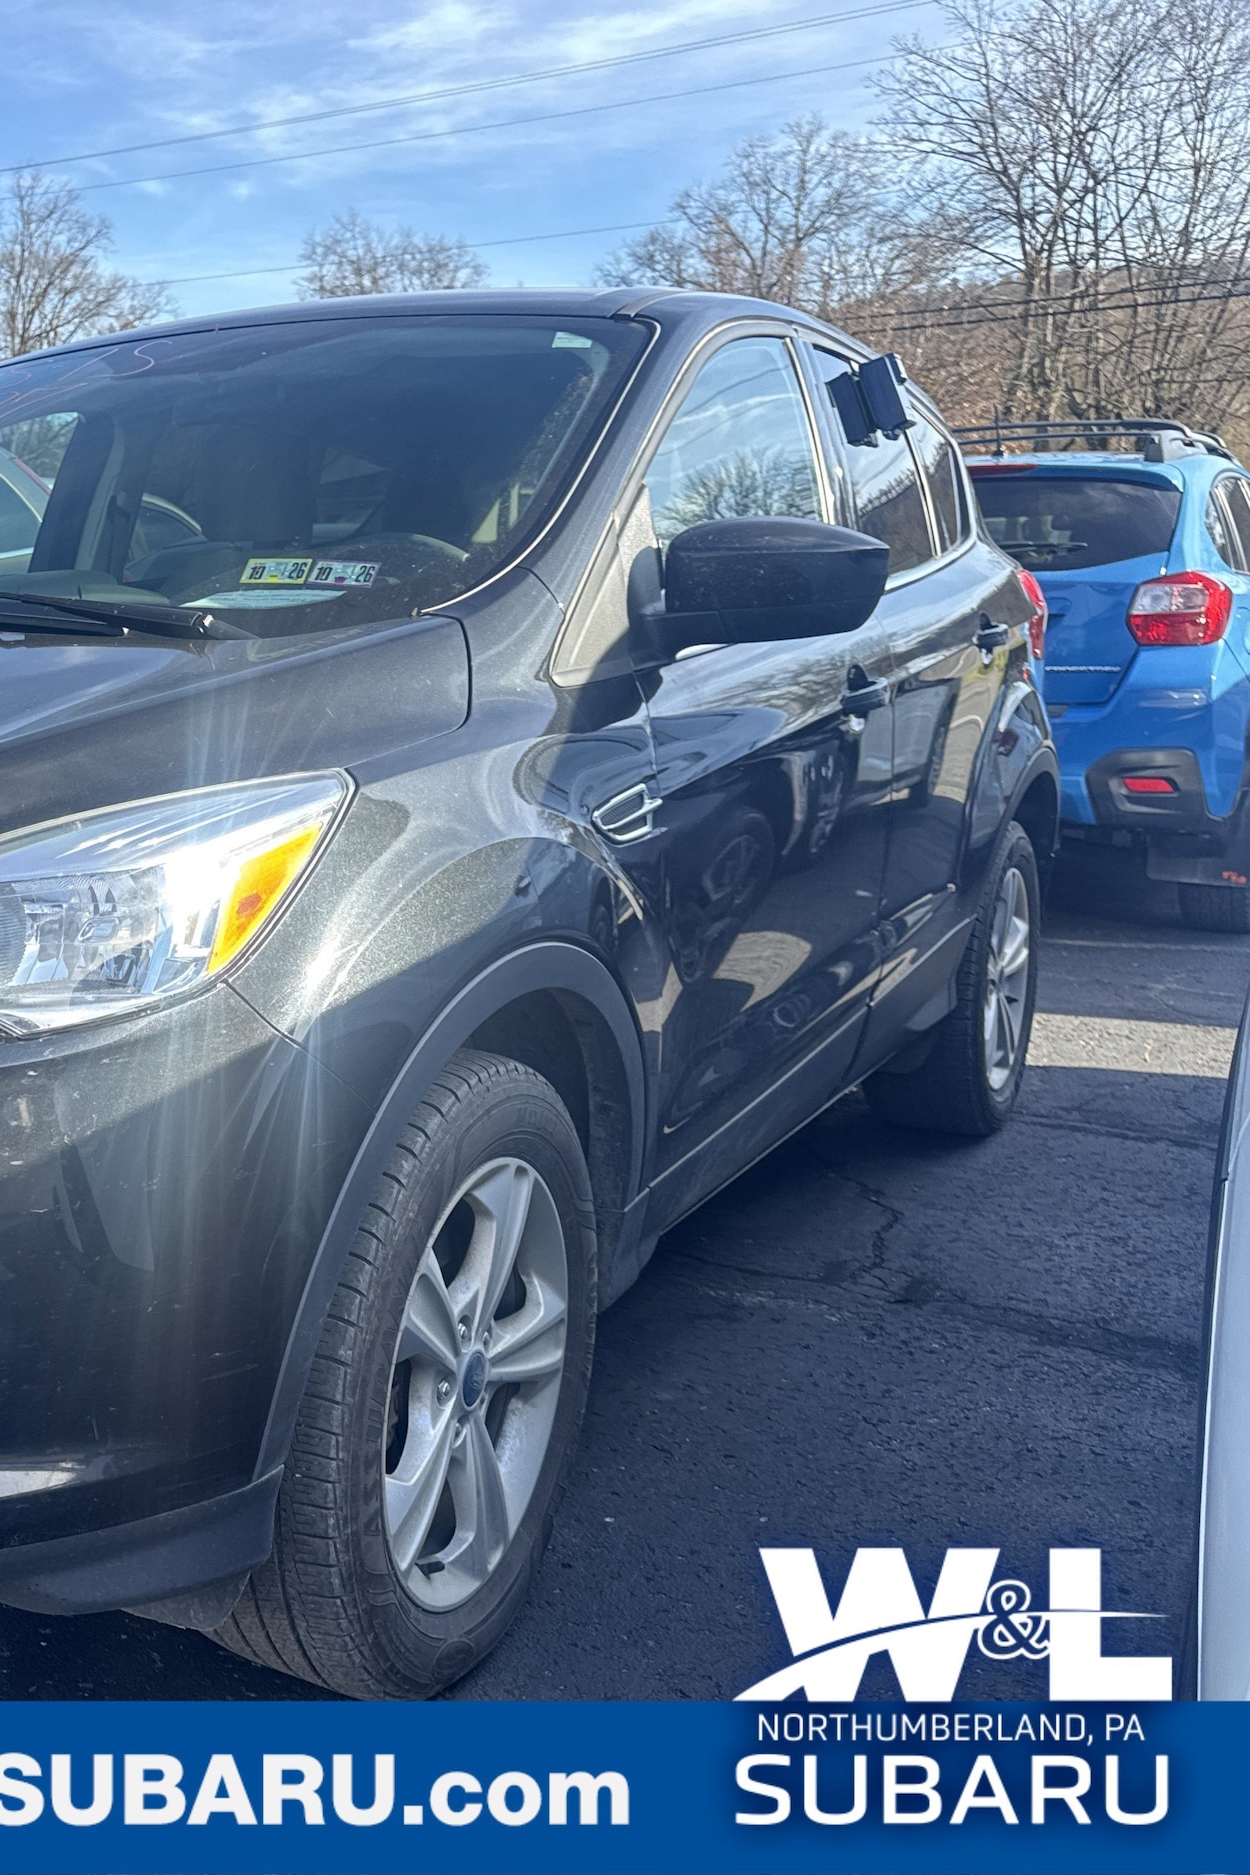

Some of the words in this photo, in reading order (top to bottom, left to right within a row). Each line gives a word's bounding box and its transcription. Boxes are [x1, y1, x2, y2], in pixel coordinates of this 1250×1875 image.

[249, 565, 266, 580] 10
[287, 562, 308, 579] 26
[314, 566, 333, 581] 10
[354, 565, 376, 583] 26
